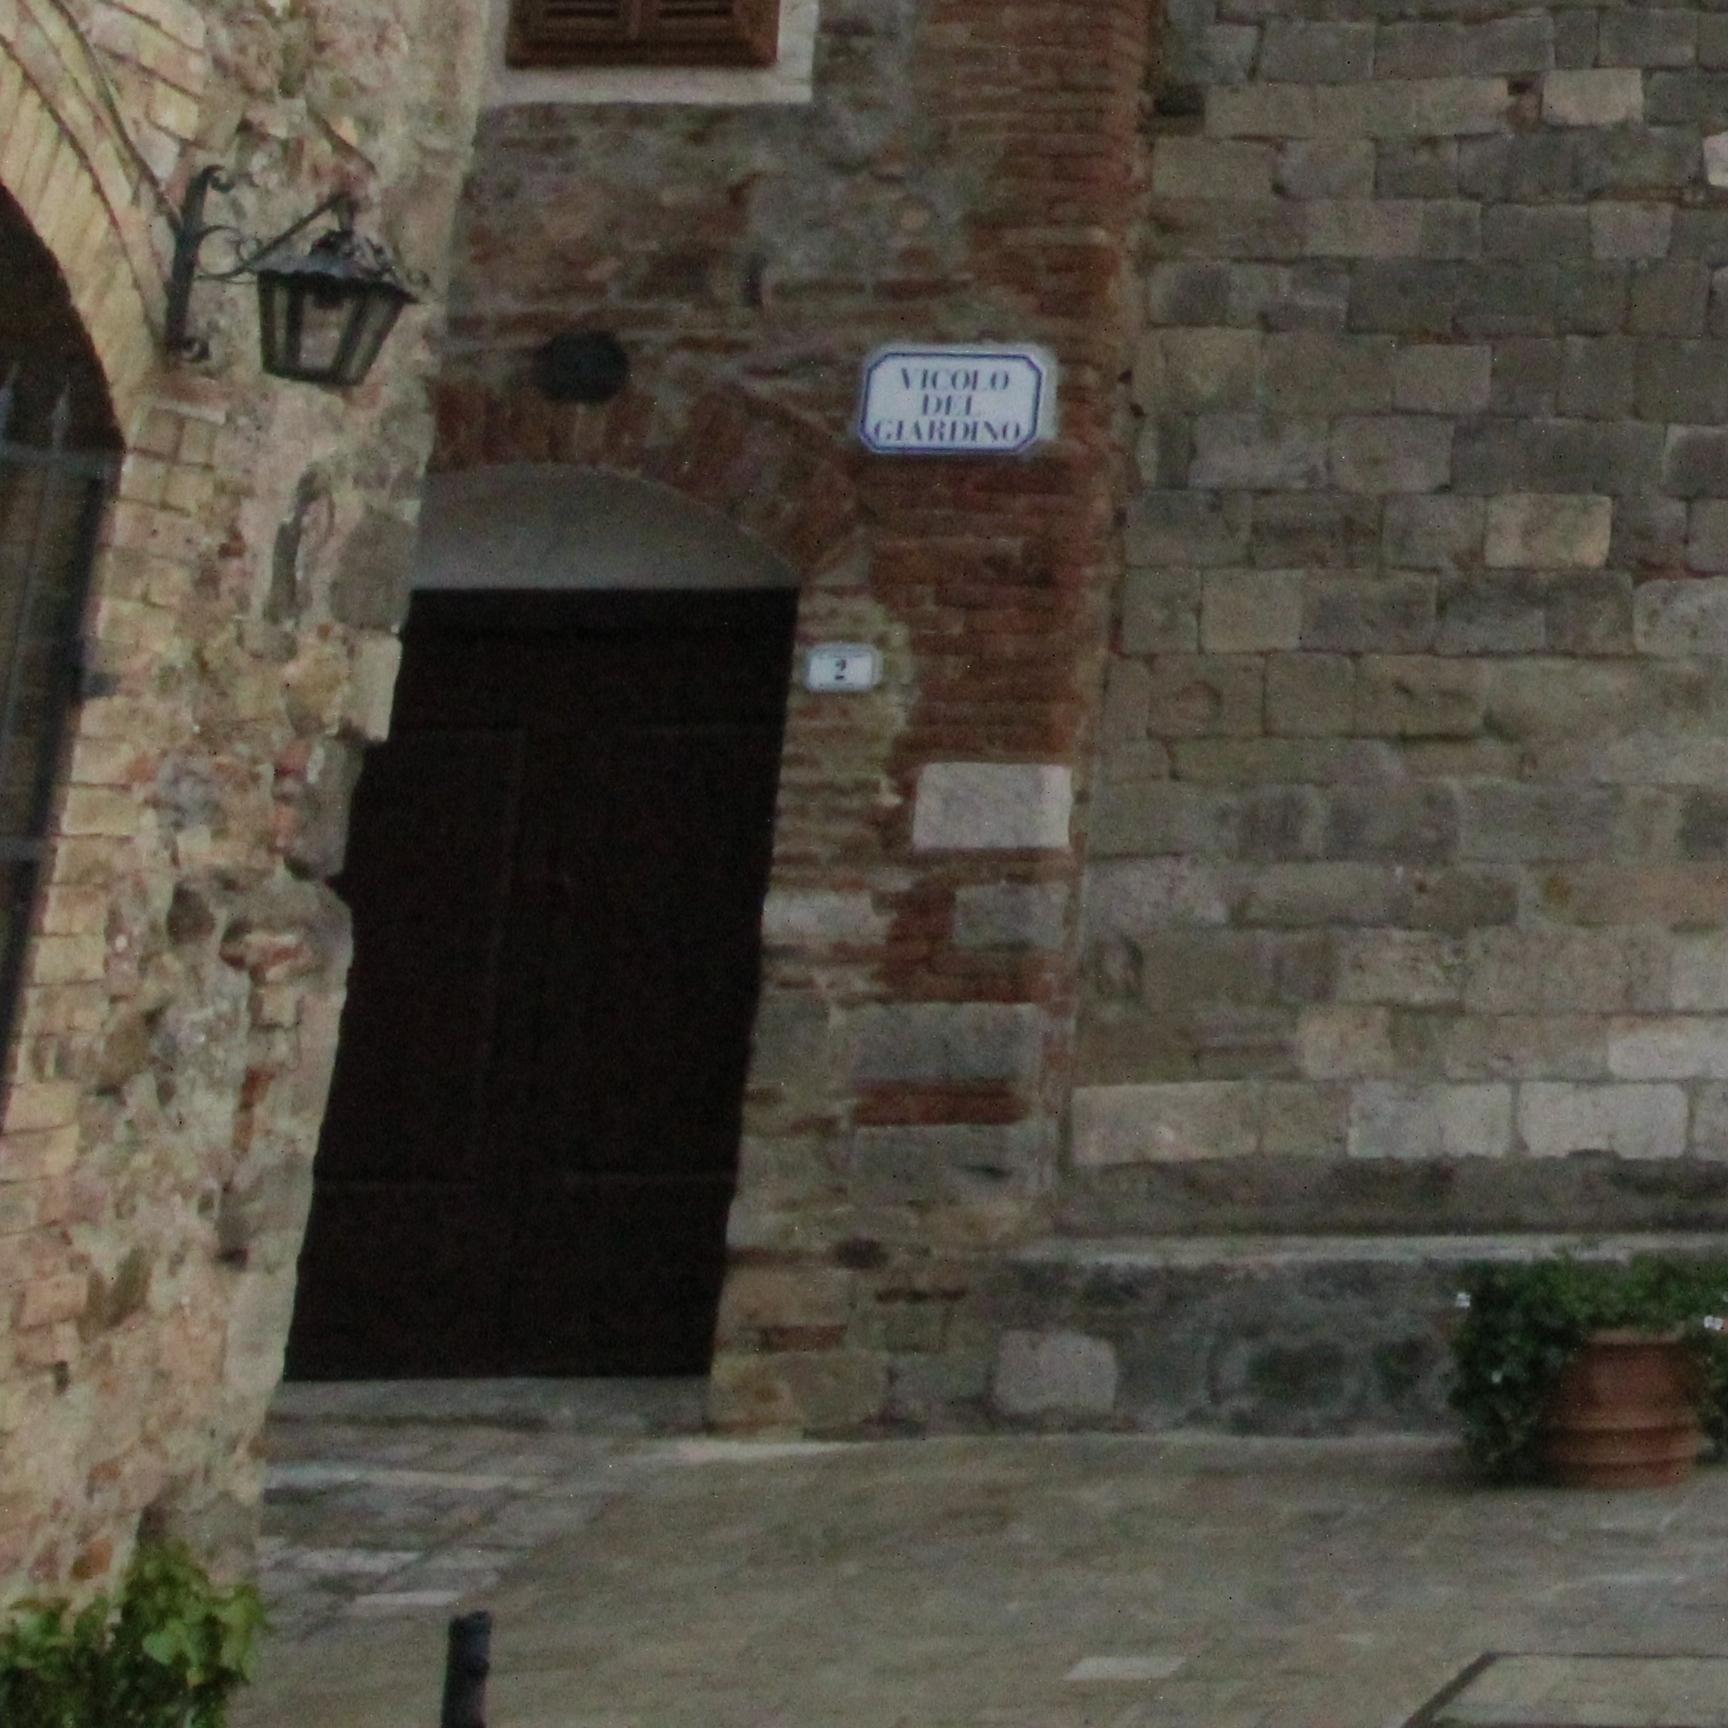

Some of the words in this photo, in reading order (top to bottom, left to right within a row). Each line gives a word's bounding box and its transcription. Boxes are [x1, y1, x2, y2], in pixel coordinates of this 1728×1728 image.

[901, 368, 1010, 390] VICOLO
[921, 394, 981, 415] DEL
[873, 420, 1021, 441] GIARDINO
[834, 659, 847, 680] 2
